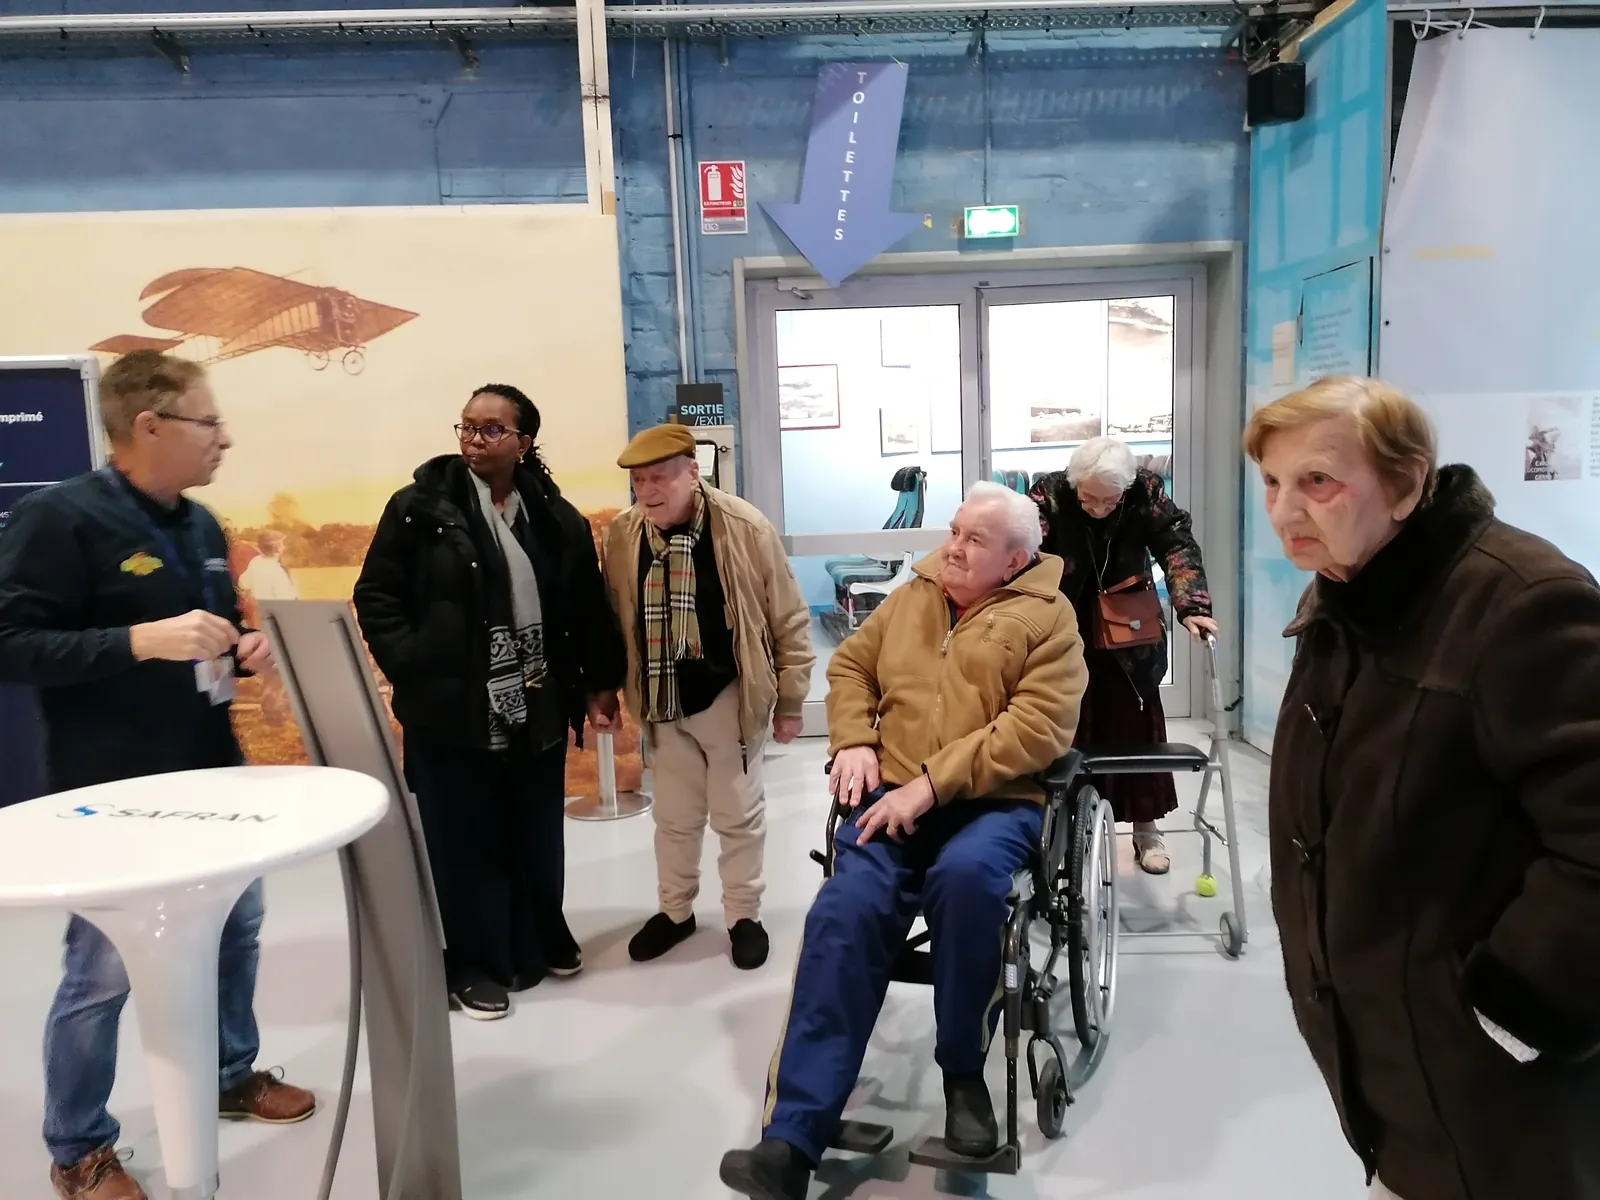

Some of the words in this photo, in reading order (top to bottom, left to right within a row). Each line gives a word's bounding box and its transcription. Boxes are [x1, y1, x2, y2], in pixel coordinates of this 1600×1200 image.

[834, 72, 867, 240] TOILETTES
[681, 404, 724, 415] SORTIE
[695, 416, 724, 426] /EXIT
[108, 809, 278, 822] SAFRAN
